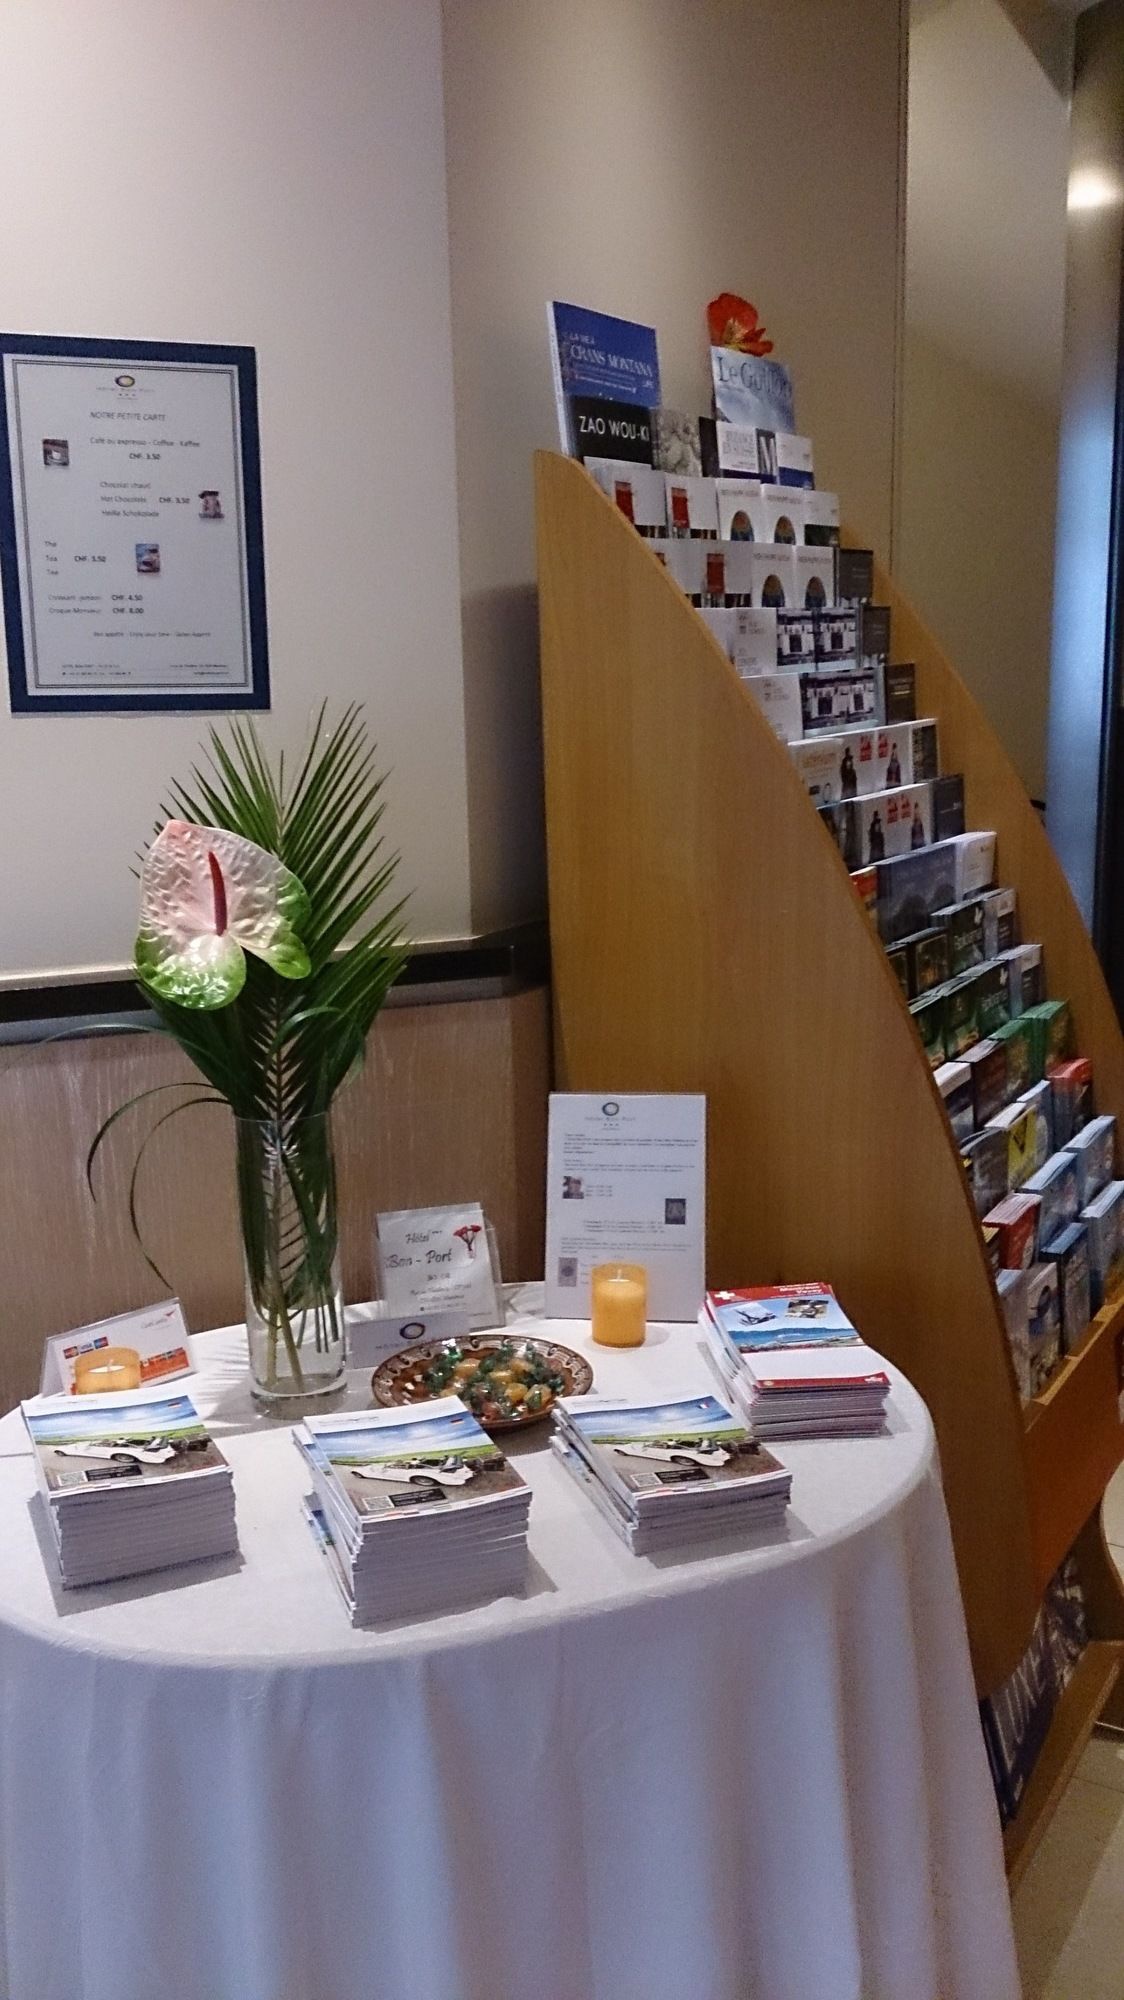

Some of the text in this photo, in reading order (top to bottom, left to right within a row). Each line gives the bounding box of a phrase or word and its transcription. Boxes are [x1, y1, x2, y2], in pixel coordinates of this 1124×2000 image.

[570, 345, 606, 367] CRANS
[607, 354, 654, 377] MONTANA
[89, 411, 167, 421] NOTRE PETITE CARTE
[579, 415, 650, 441] ZAO WOU-KI
[425, 1247, 453, 1264] Port
